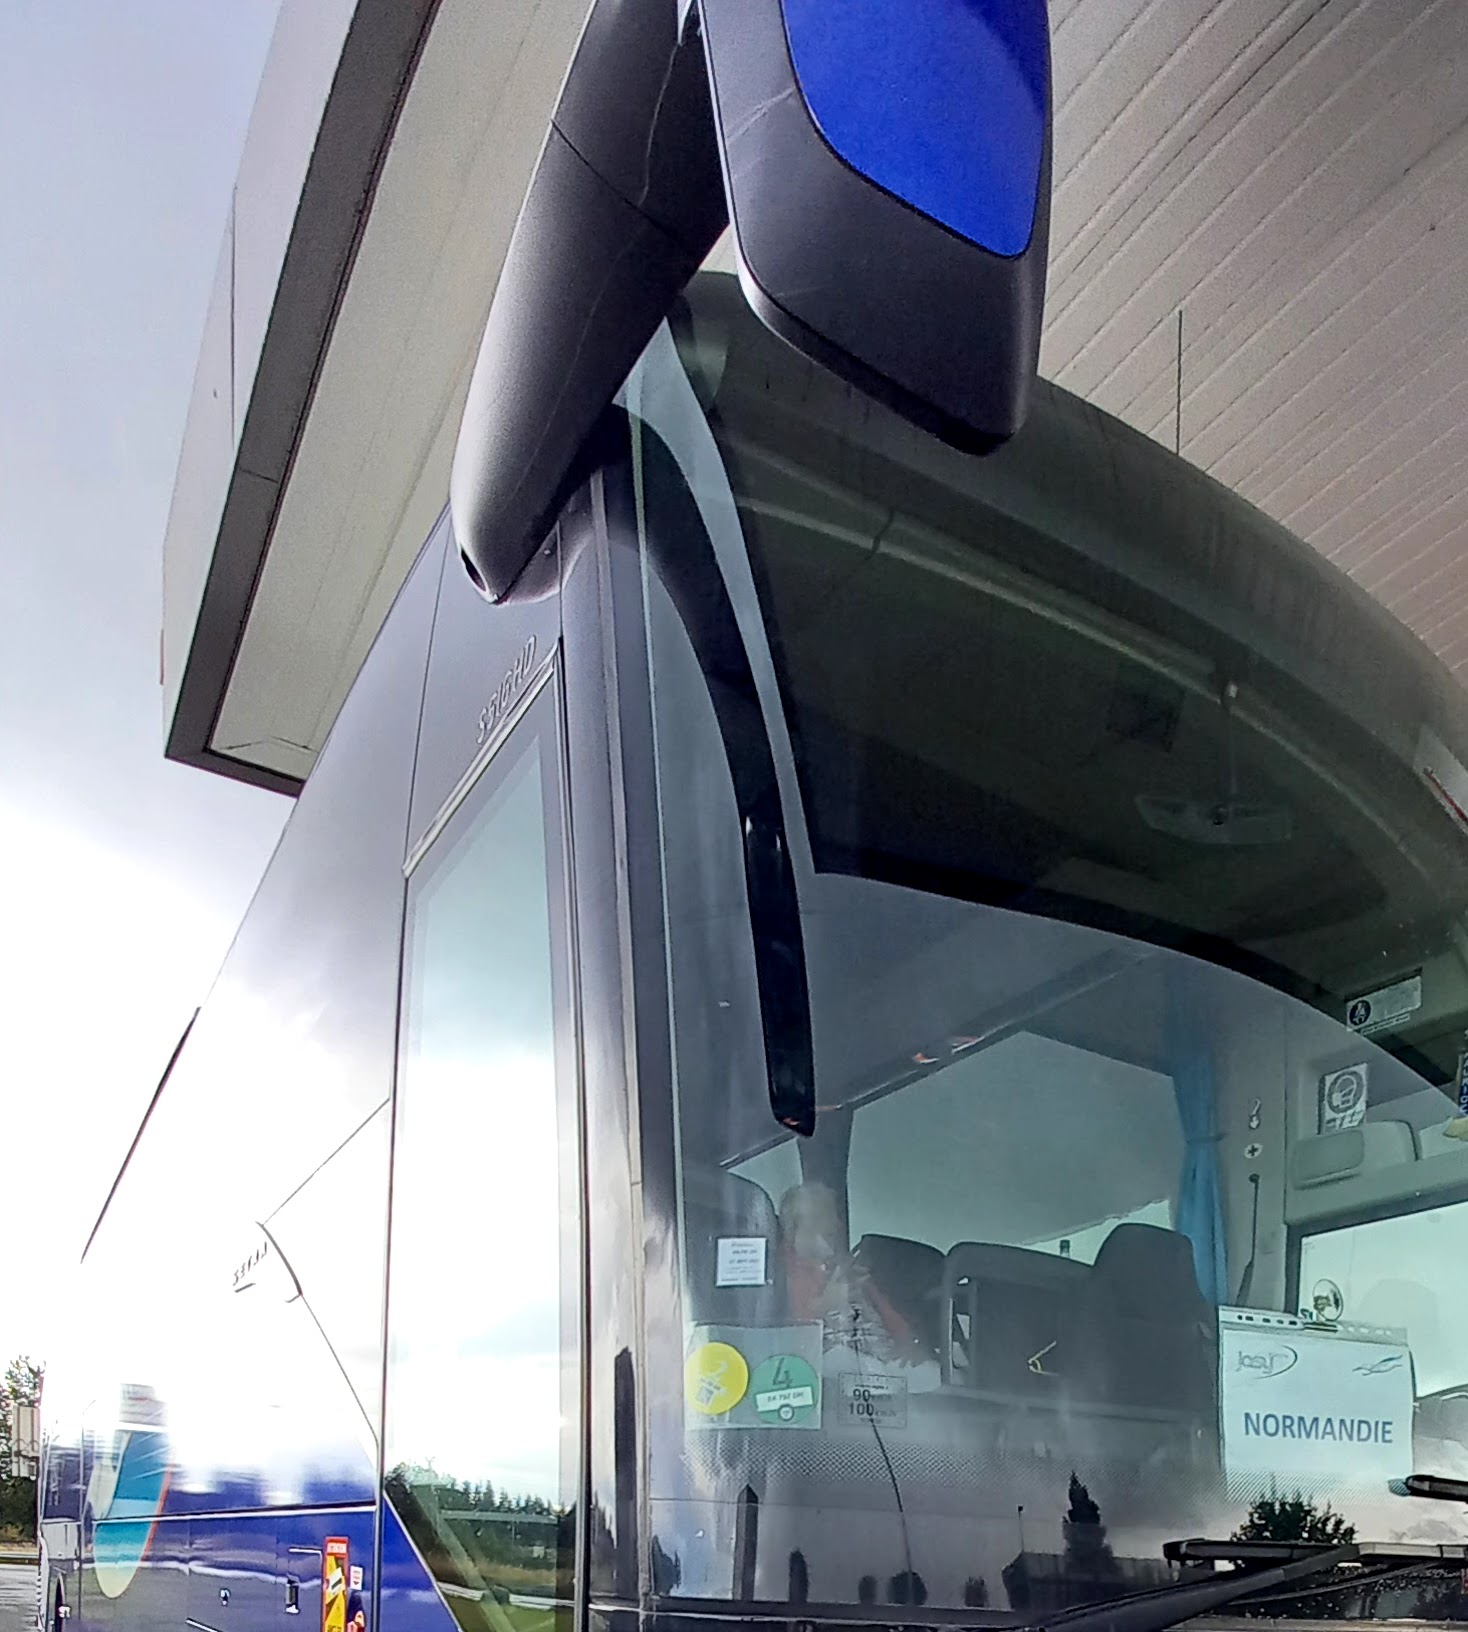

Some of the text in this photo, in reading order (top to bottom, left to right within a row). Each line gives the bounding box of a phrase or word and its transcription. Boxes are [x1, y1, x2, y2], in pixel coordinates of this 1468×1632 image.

[853, 1388, 871, 1402] 90
[849, 1402, 875, 1416] 100
[1244, 1411, 1394, 1444] NORMANDIE
